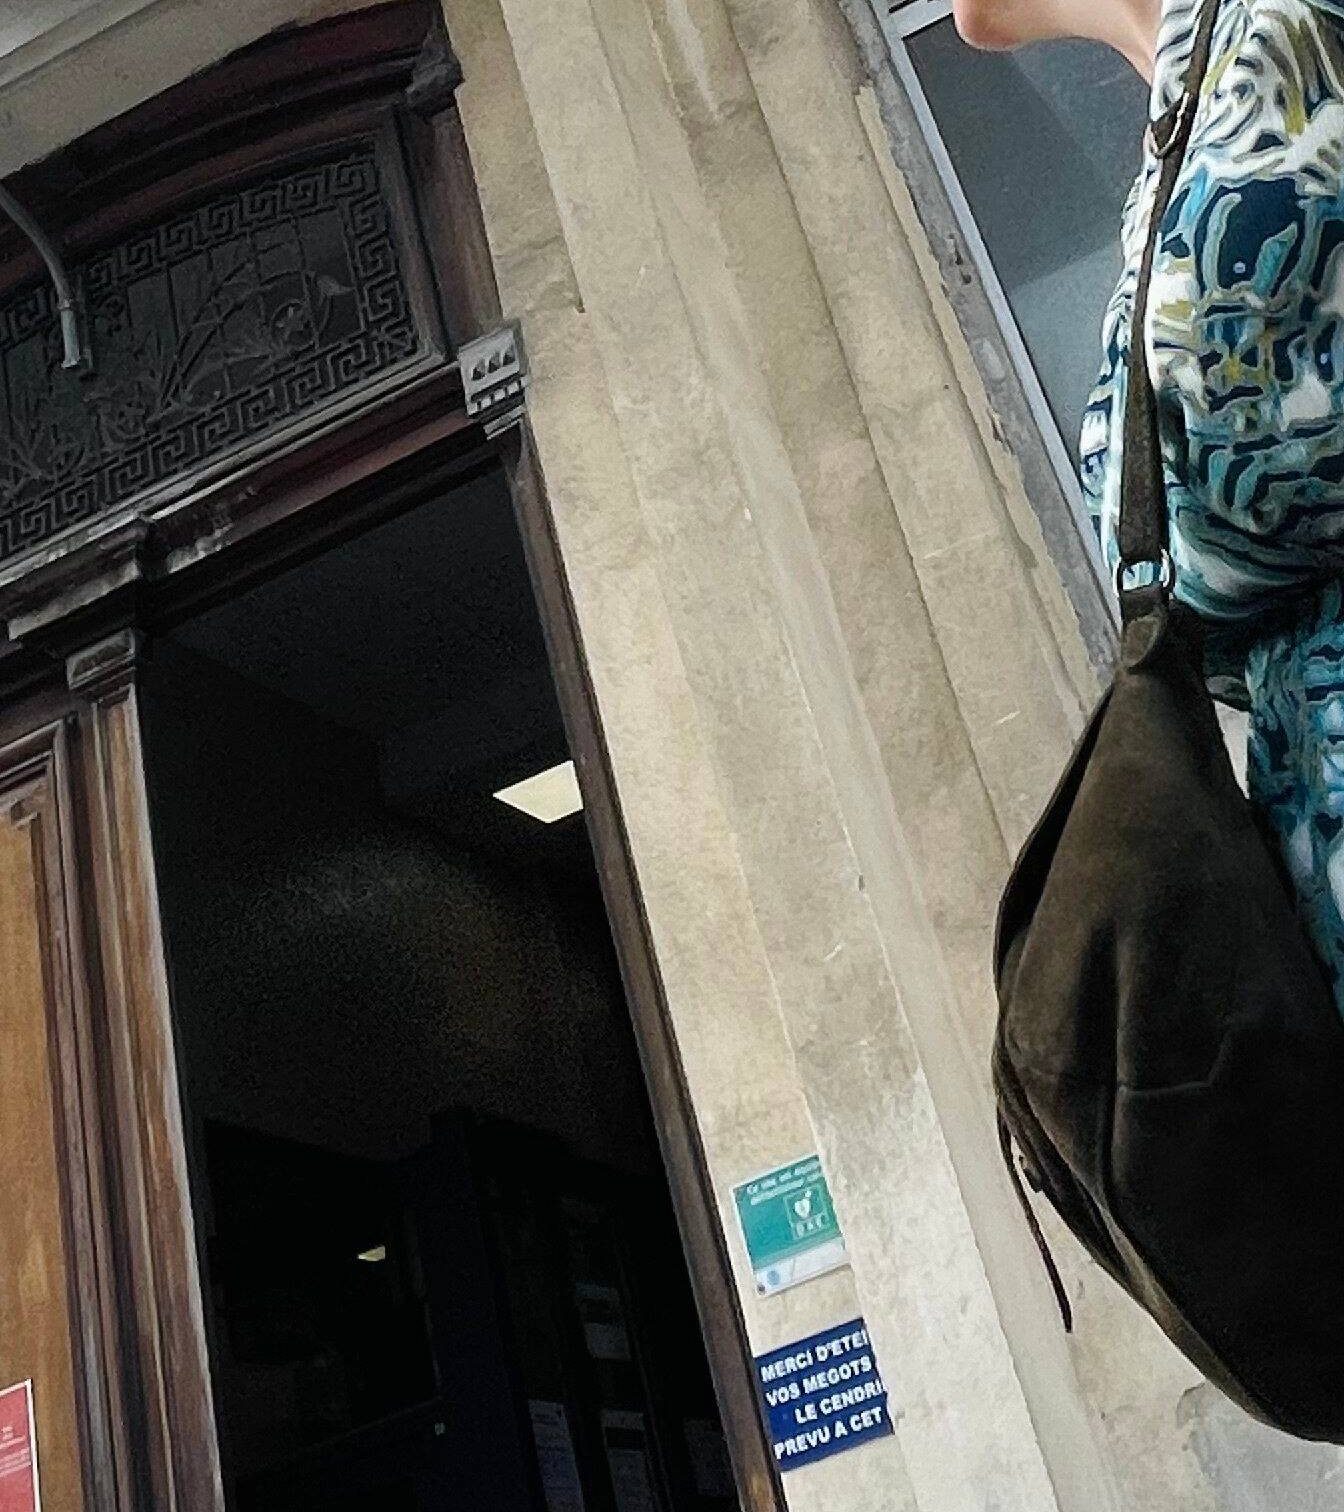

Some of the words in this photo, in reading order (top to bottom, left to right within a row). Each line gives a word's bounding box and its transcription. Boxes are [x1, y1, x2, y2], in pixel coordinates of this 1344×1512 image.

[760, 1349, 814, 1382] MERCI
[765, 1382, 801, 1407] VOS
[802, 1354, 872, 1394] MEGOTS
[773, 1425, 830, 1460] PREVU
[834, 1420, 848, 1438] A
[849, 1406, 882, 1432] CET
[794, 1402, 818, 1424] LE
